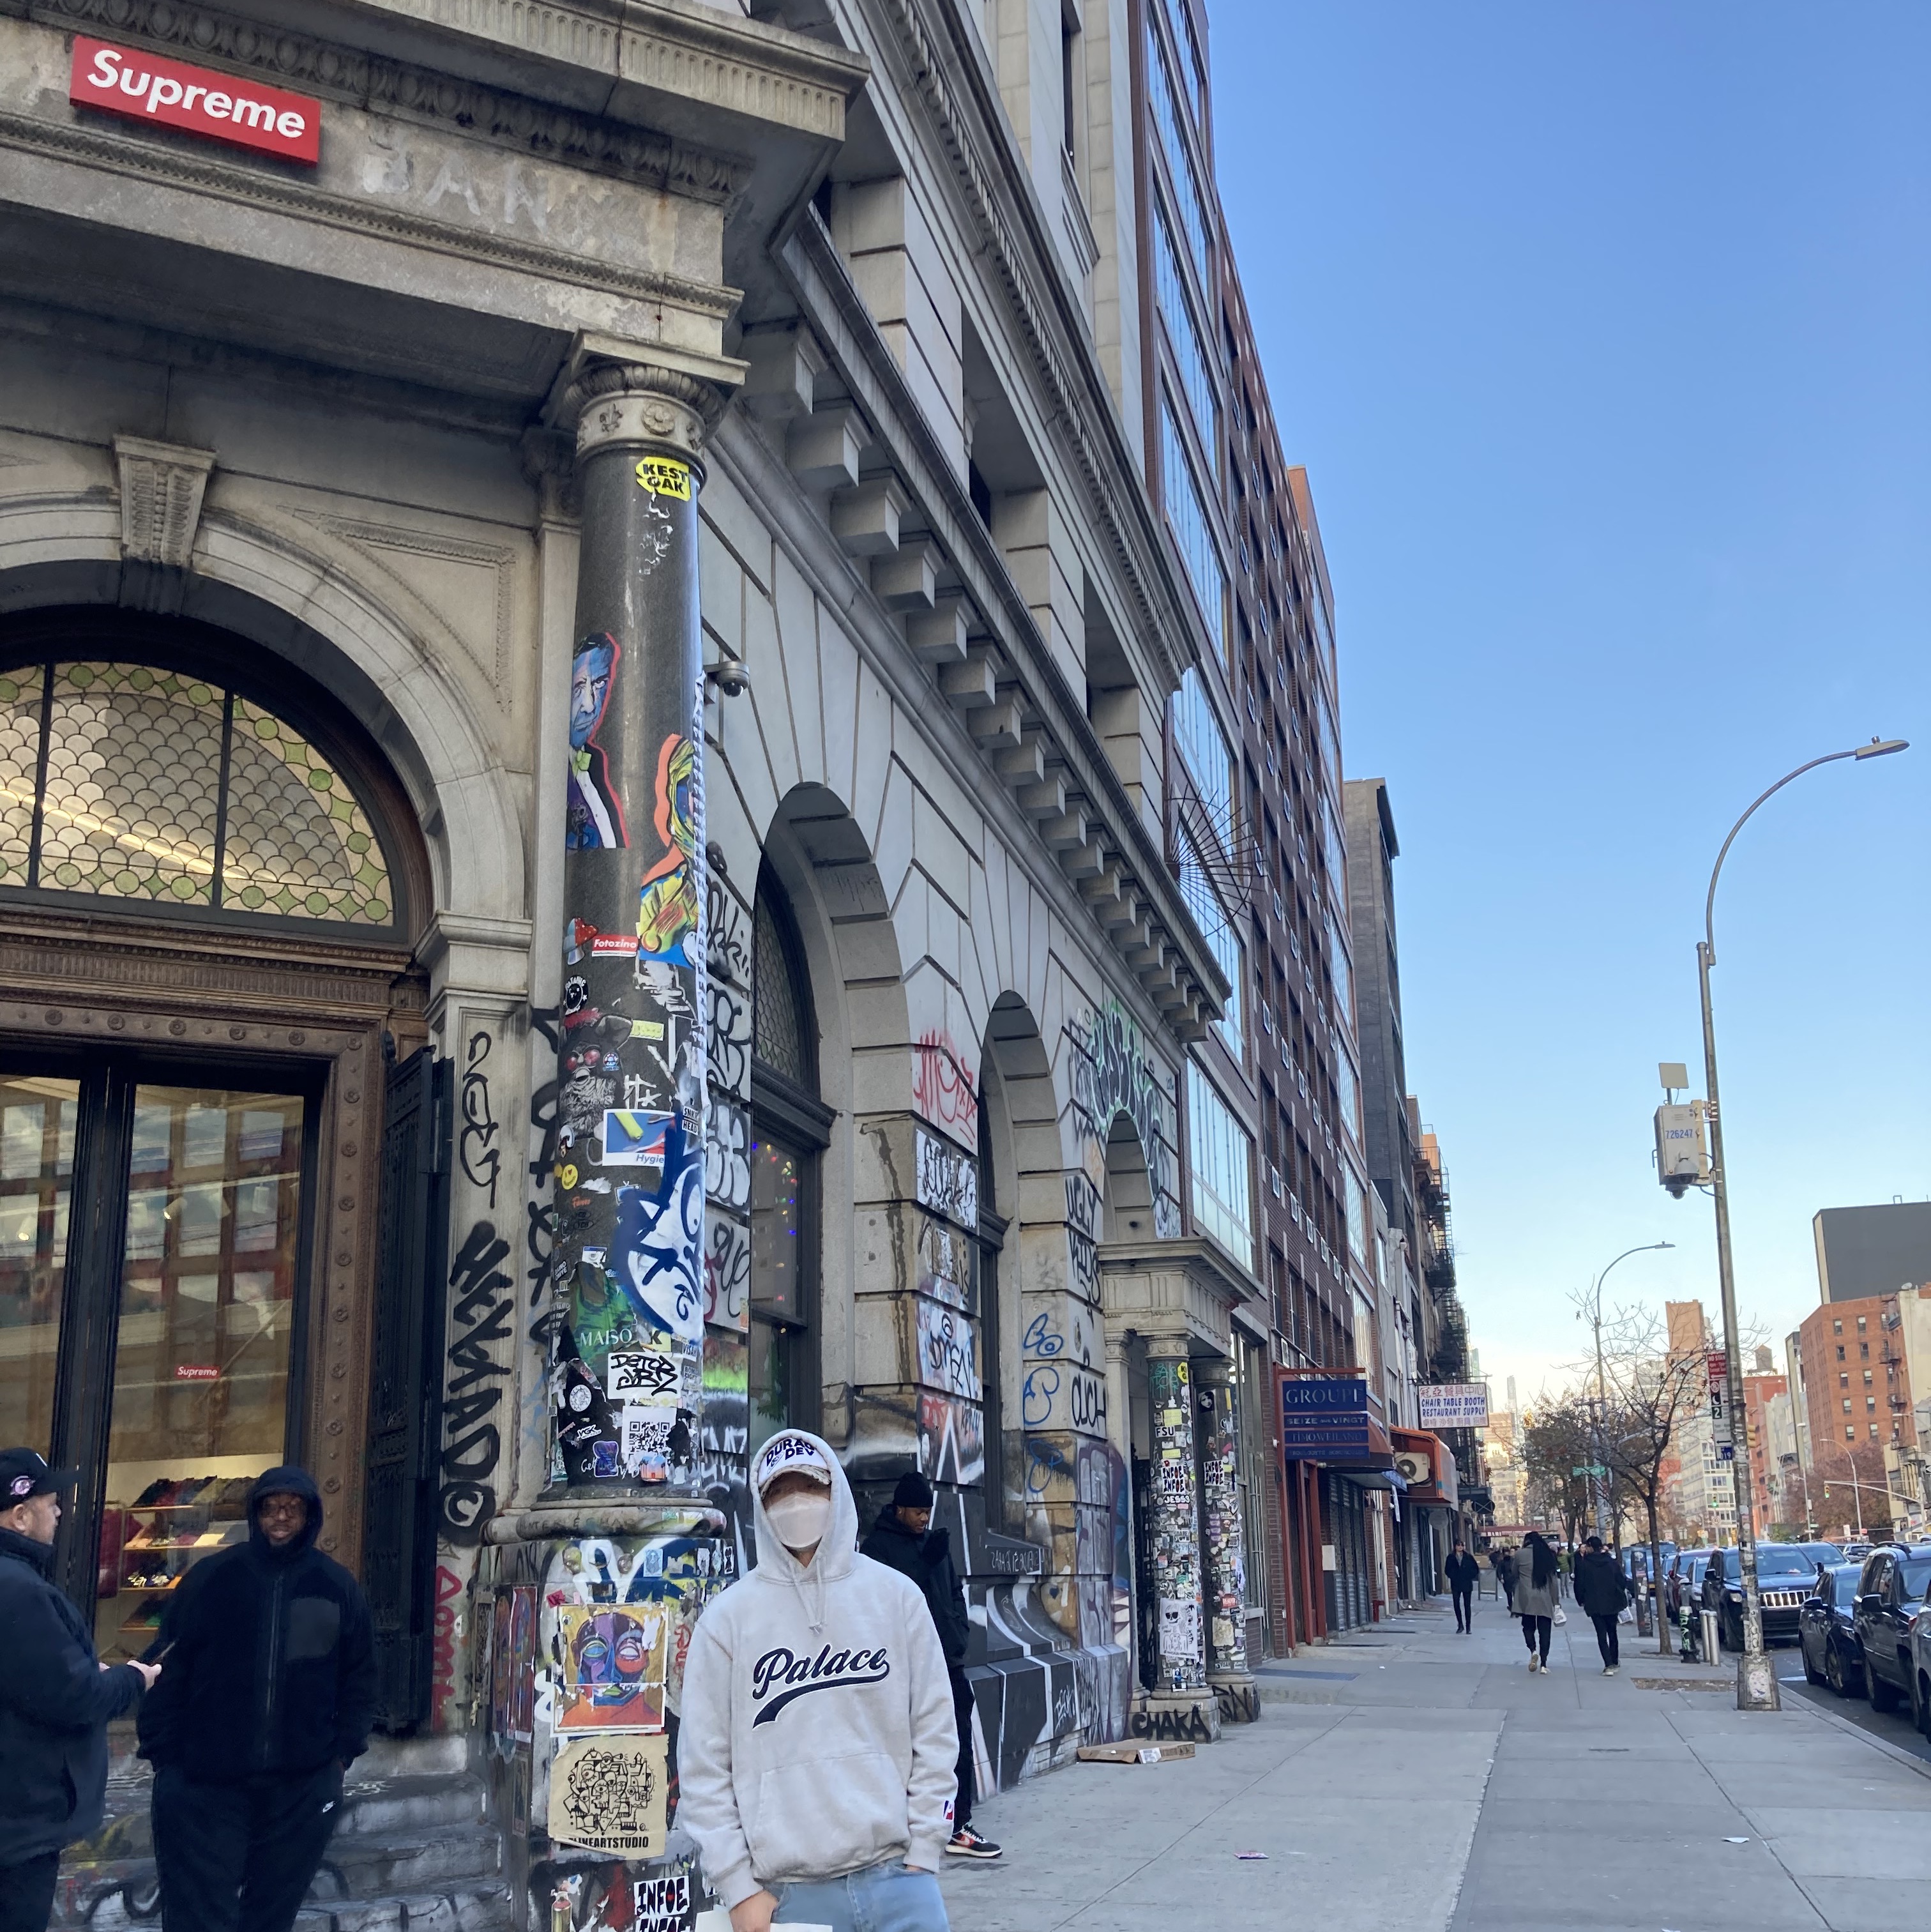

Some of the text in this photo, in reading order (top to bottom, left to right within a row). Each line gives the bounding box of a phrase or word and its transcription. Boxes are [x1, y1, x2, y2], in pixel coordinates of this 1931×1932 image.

[87, 49, 306, 139] Supreme
[642, 464, 688, 483] KEST
[683, 1122, 697, 1134] HEAD
[1665, 1129, 1693, 1139] 726247
[636, 1153, 665, 1165] Hygie
[178, 1366, 217, 1378] Supreme
[1286, 1388, 1364, 1403] GROUPE
[1422, 1397, 1485, 1407] CHAIR TABLE BOOTH
[1423, 1407, 1485, 1417] RESTAURANT SUPPLY
[1156, 1427, 1174, 1436] FSU
[785, 1447, 815, 1460] DEV
[752, 1643, 888, 1700] Palace
[1132, 1705, 1211, 1744] CHAKA
[568, 1836, 649, 1848] INEARTSTUDIO
[637, 1877, 688, 1916] INFOE
